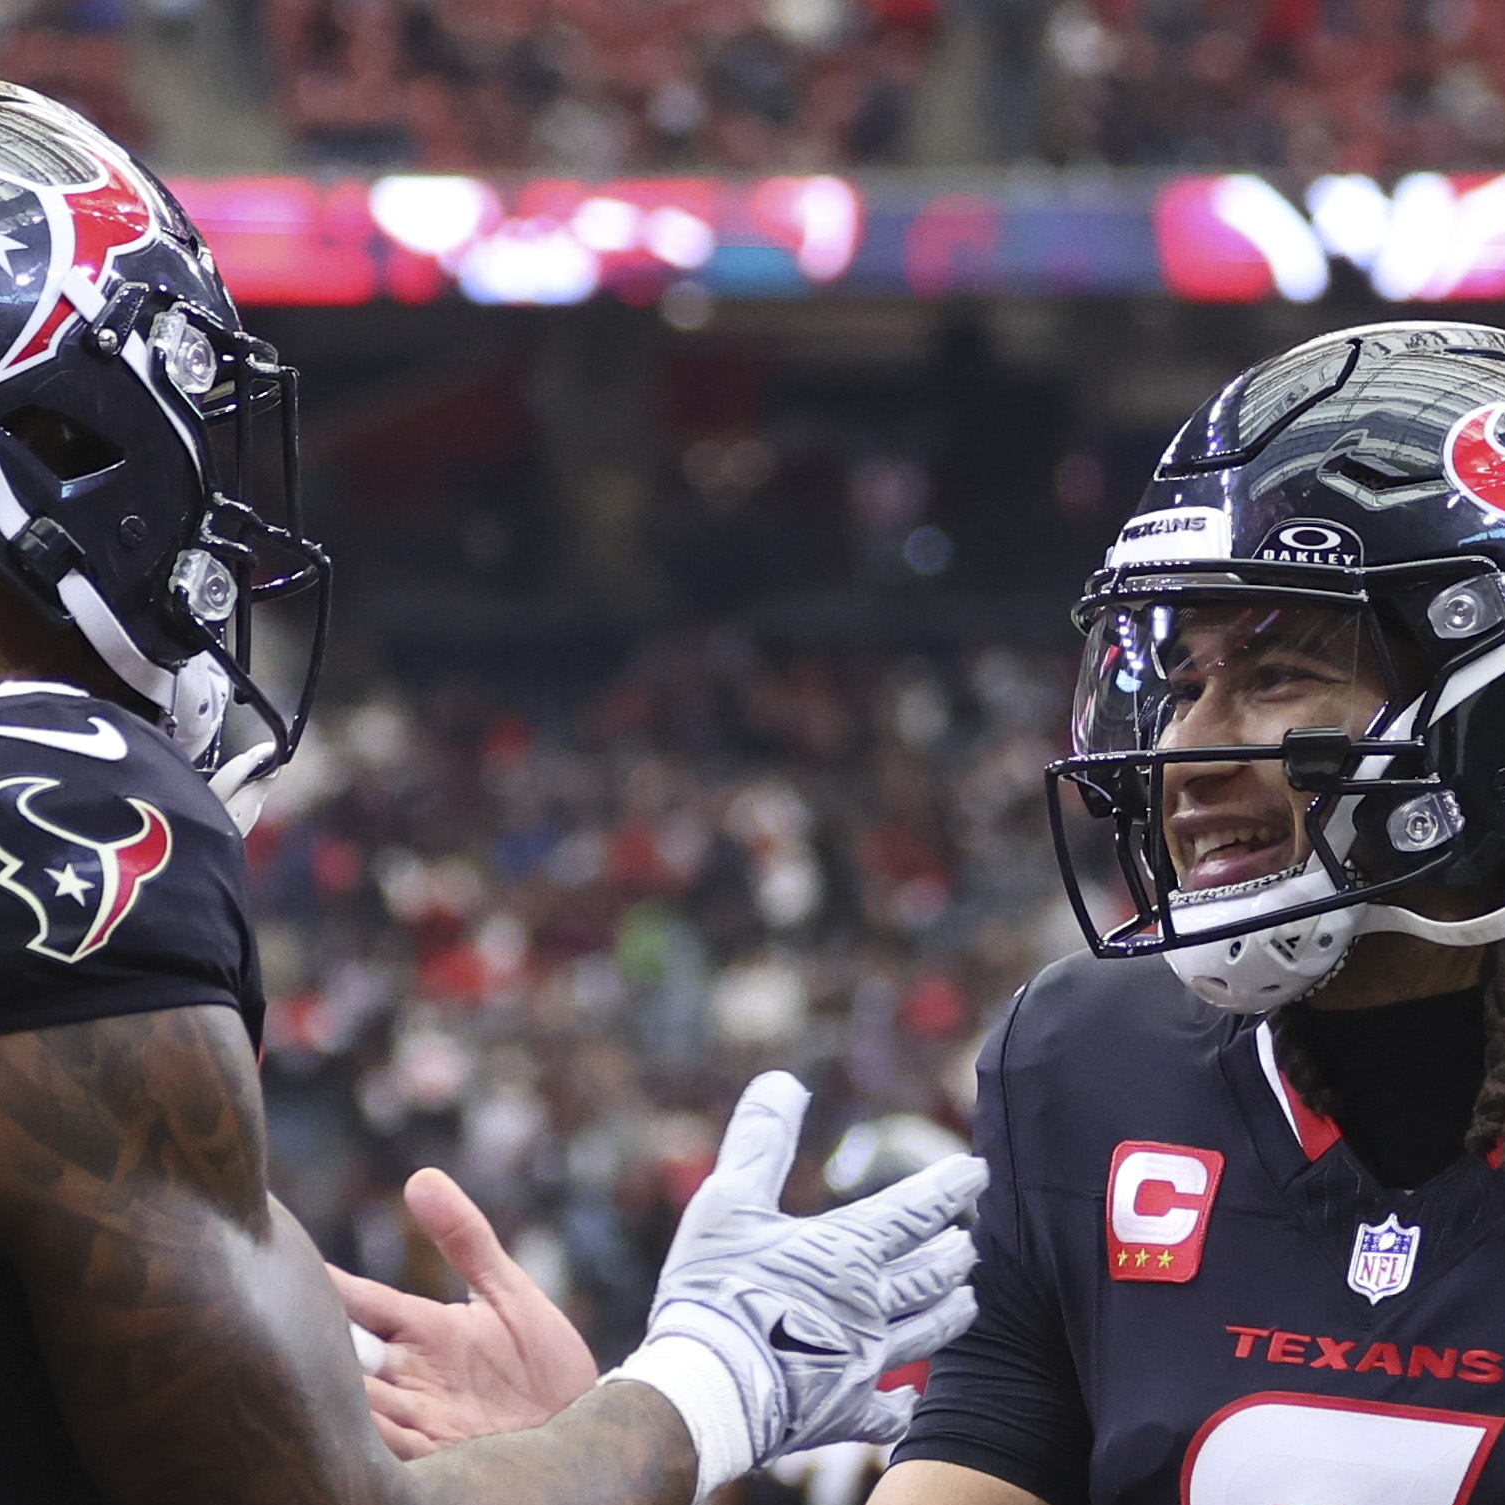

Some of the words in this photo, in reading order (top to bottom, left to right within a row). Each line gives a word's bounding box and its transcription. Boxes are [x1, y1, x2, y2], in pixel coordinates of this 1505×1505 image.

[1121, 517, 1207, 542] TEXANS
[1263, 549, 1356, 565] OAKLEY
[1111, 1151, 1209, 1246] C
[1359, 1255, 1400, 1287] NFL
[1225, 1325, 1505, 1384] TEXANS
